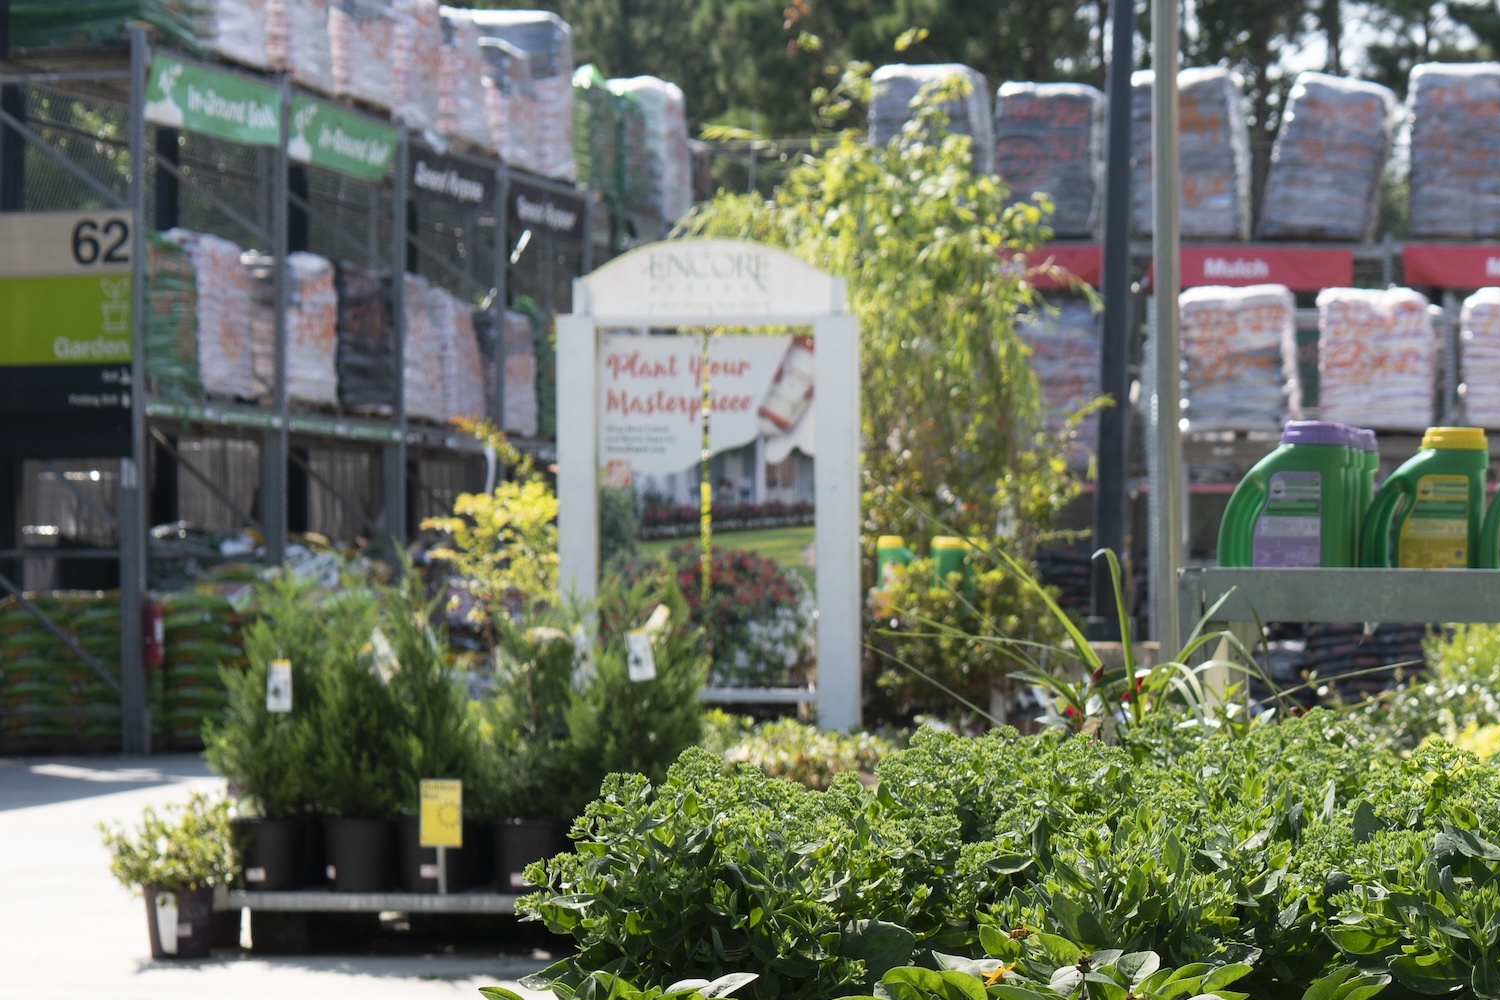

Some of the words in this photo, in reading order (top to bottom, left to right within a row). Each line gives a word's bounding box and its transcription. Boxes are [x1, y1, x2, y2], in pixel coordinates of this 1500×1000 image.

[71, 218, 130, 267] 62
[641, 251, 770, 293] ENCORE
[1204, 257, 1270, 279] Mulch
[53, 335, 129, 360] Garden
[606, 350, 679, 379] Plant
[688, 353, 751, 388] Your
[606, 388, 753, 424] Masterpiece
